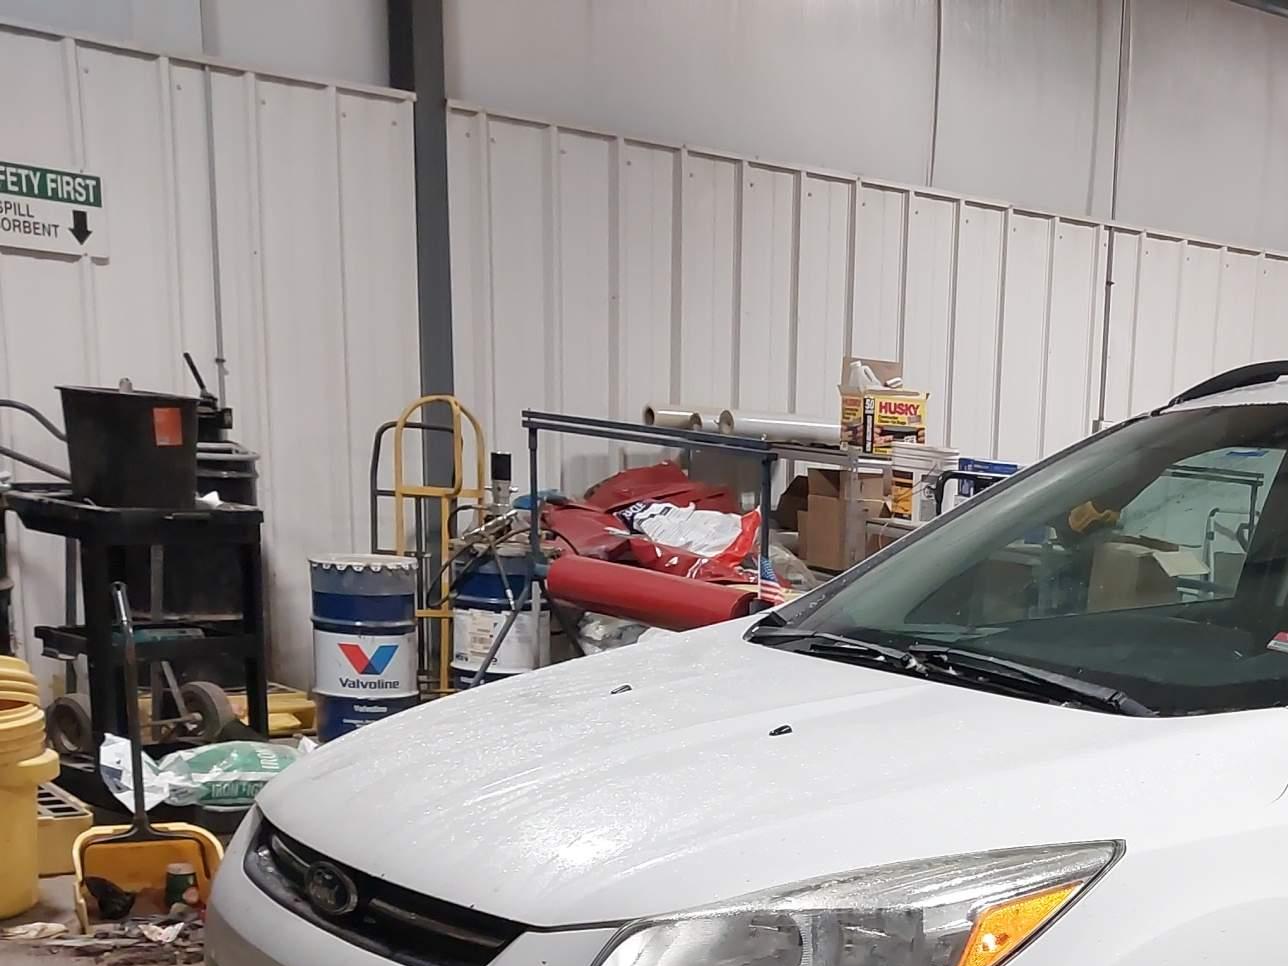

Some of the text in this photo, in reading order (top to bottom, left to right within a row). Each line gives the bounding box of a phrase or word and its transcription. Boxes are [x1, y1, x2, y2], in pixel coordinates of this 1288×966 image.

[46, 173, 97, 203] FIRST
[879, 401, 920, 416] HUSKY
[339, 677, 400, 690] Valvoline
